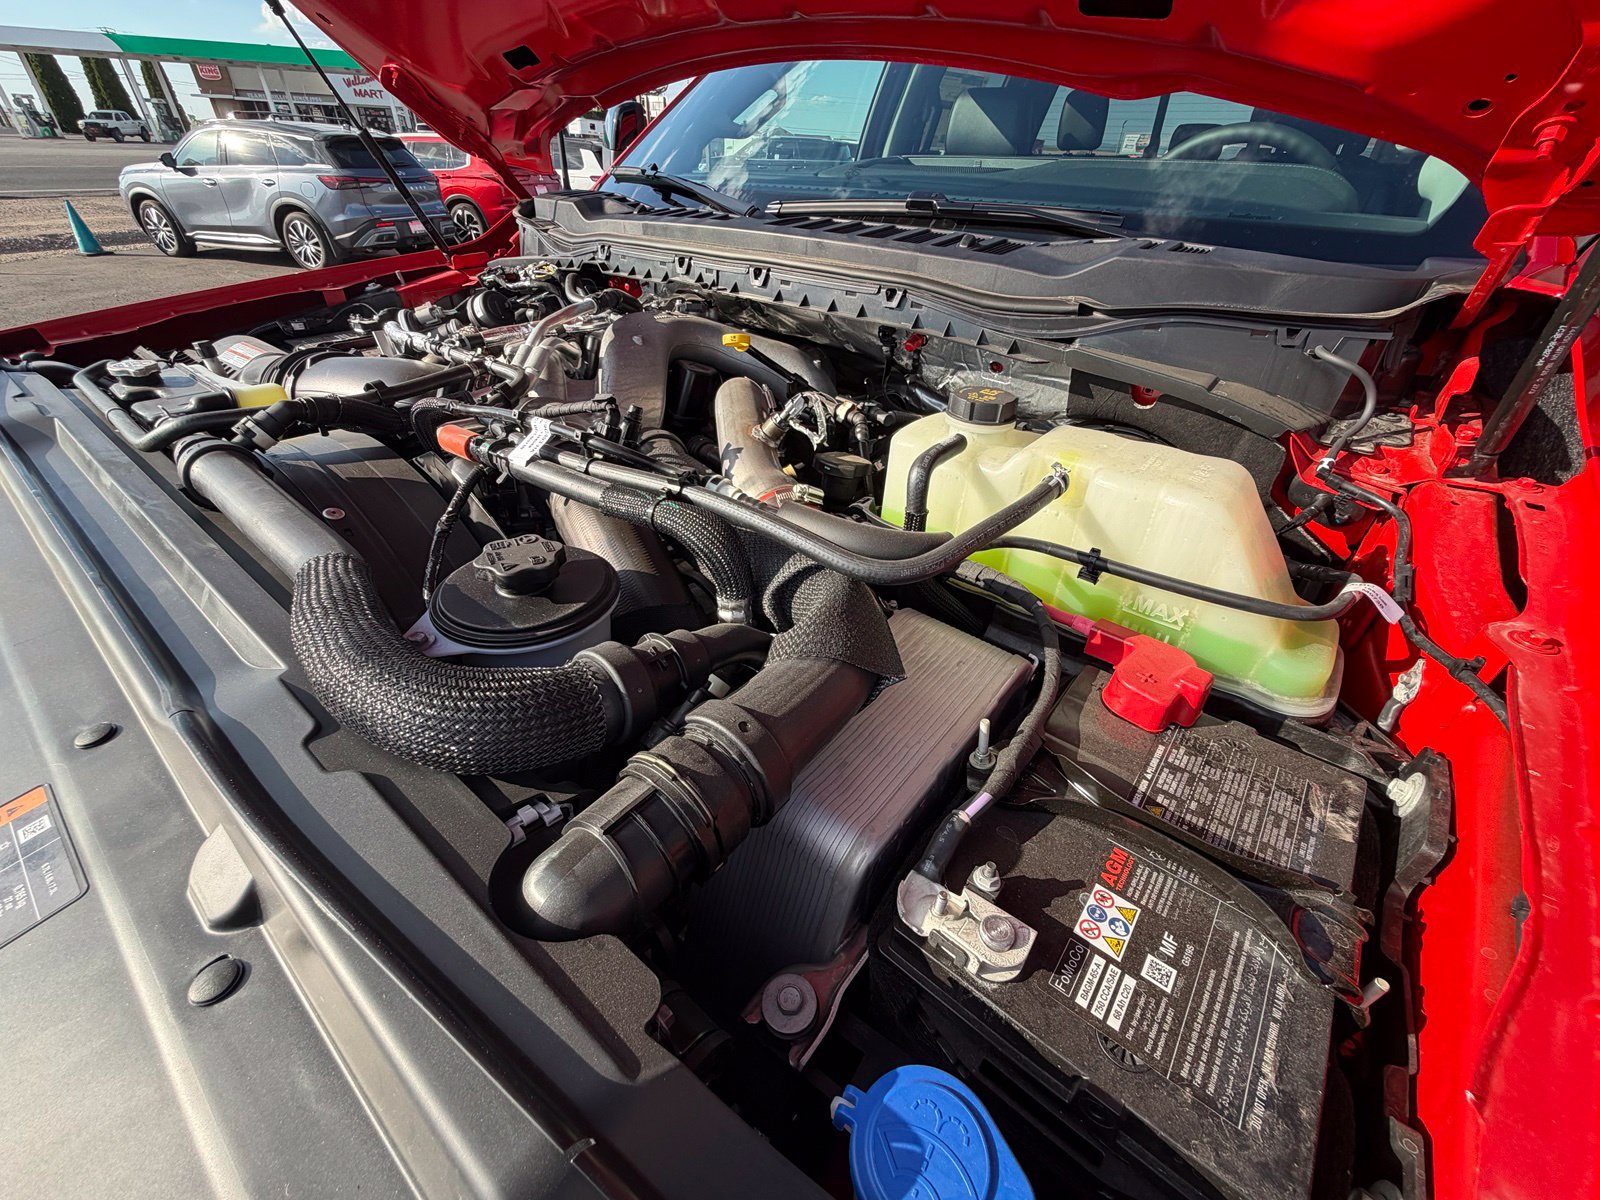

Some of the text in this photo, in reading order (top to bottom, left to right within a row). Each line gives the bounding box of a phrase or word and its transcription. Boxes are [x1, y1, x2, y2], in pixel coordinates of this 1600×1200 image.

[200, 67, 219, 75] KING
[353, 89, 384, 99] MART
[1133, 594, 1189, 626] MAX
[1098, 846, 1128, 887] AGM
[1115, 855, 1135, 891] TECHNOLOGY
[1158, 930, 1180, 958] MF
[1180, 943, 1195, 967] G519S
[1054, 942, 1084, 991] FoMoCo
[1079, 961, 1101, 1000] BAGM-65-A
[1093, 967, 1118, 1015] 750 CCA/SAE
[1112, 983, 1132, 1020] 68 Ah C20
[1125, 1025, 1135, 1040] Dist.
[1143, 1037, 1153, 1052] Ford
[1148, 1020, 1159, 1039] Motor
[1180, 966, 1216, 1078] Made in USA with US and imported materials.
[1153, 1030, 1167, 1059] Dearborn,
[1199, 1049, 1208, 1062] aux
[1216, 1046, 1224, 1059] los
[1253, 1097, 1266, 1117] NOT
[1264, 1047, 1275, 1065] PAS
